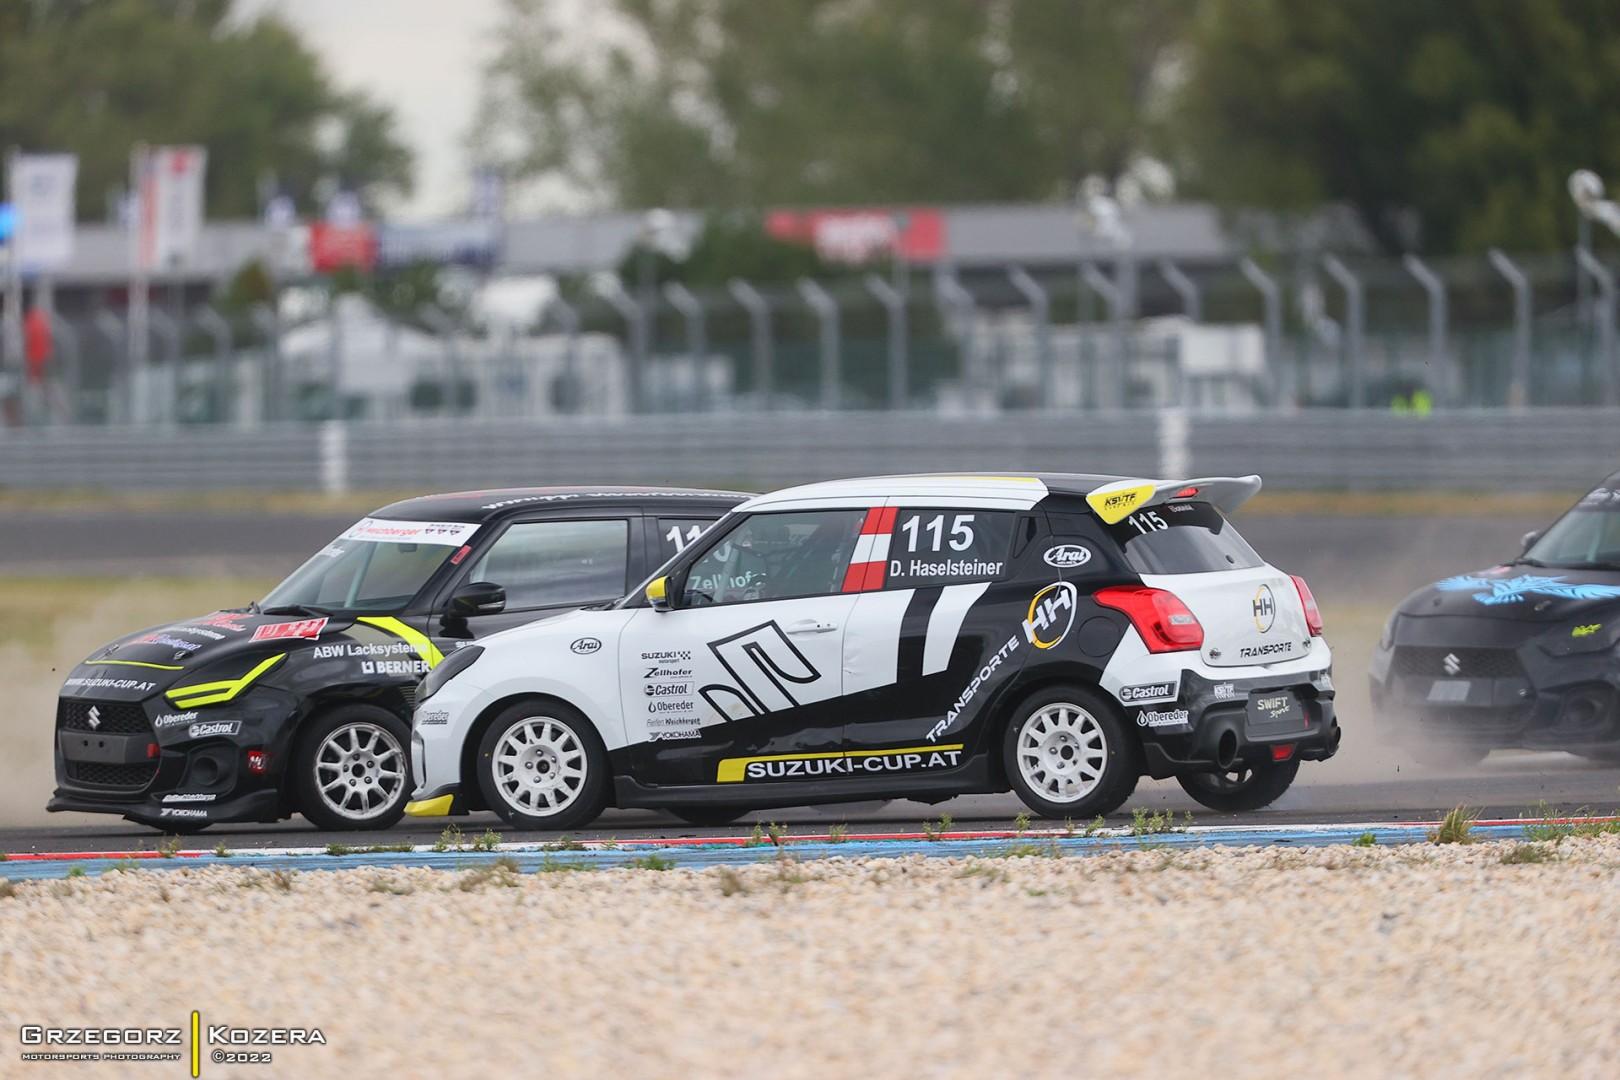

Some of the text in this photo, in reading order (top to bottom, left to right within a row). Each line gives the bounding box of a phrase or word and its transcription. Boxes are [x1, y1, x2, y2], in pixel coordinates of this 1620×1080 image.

[1128, 510, 1169, 535] 115
[902, 514, 976, 552] 115
[1050, 546, 1085, 561] Arai
[889, 560, 1004, 578] D. Haselsteiner
[1253, 597, 1274, 617] HH
[1022, 588, 1072, 644] HH
[313, 642, 429, 659] ABW Lacksysteme
[572, 639, 598, 650] Arai
[1240, 642, 1292, 658] TRANSPORTE
[641, 651, 677, 660] SUZUKI
[377, 661, 430, 674] BERNER
[643, 667, 693, 679] Zellhofer
[655, 684, 688, 696] Castrol
[926, 634, 1020, 743] TRANSPORTE
[1132, 685, 1170, 699] Castrol
[657, 701, 694, 711] Obereder
[1257, 697, 1288, 710] SWIFT
[163, 711, 198, 724] Obereder
[1148, 710, 1188, 722] Obereder
[199, 723, 233, 734] Castrol
[661, 729, 701, 739] YOKOHAMA
[747, 751, 961, 778] SUZUKI-CUP.AT
[171, 808, 207, 817] YOKOHAMA
